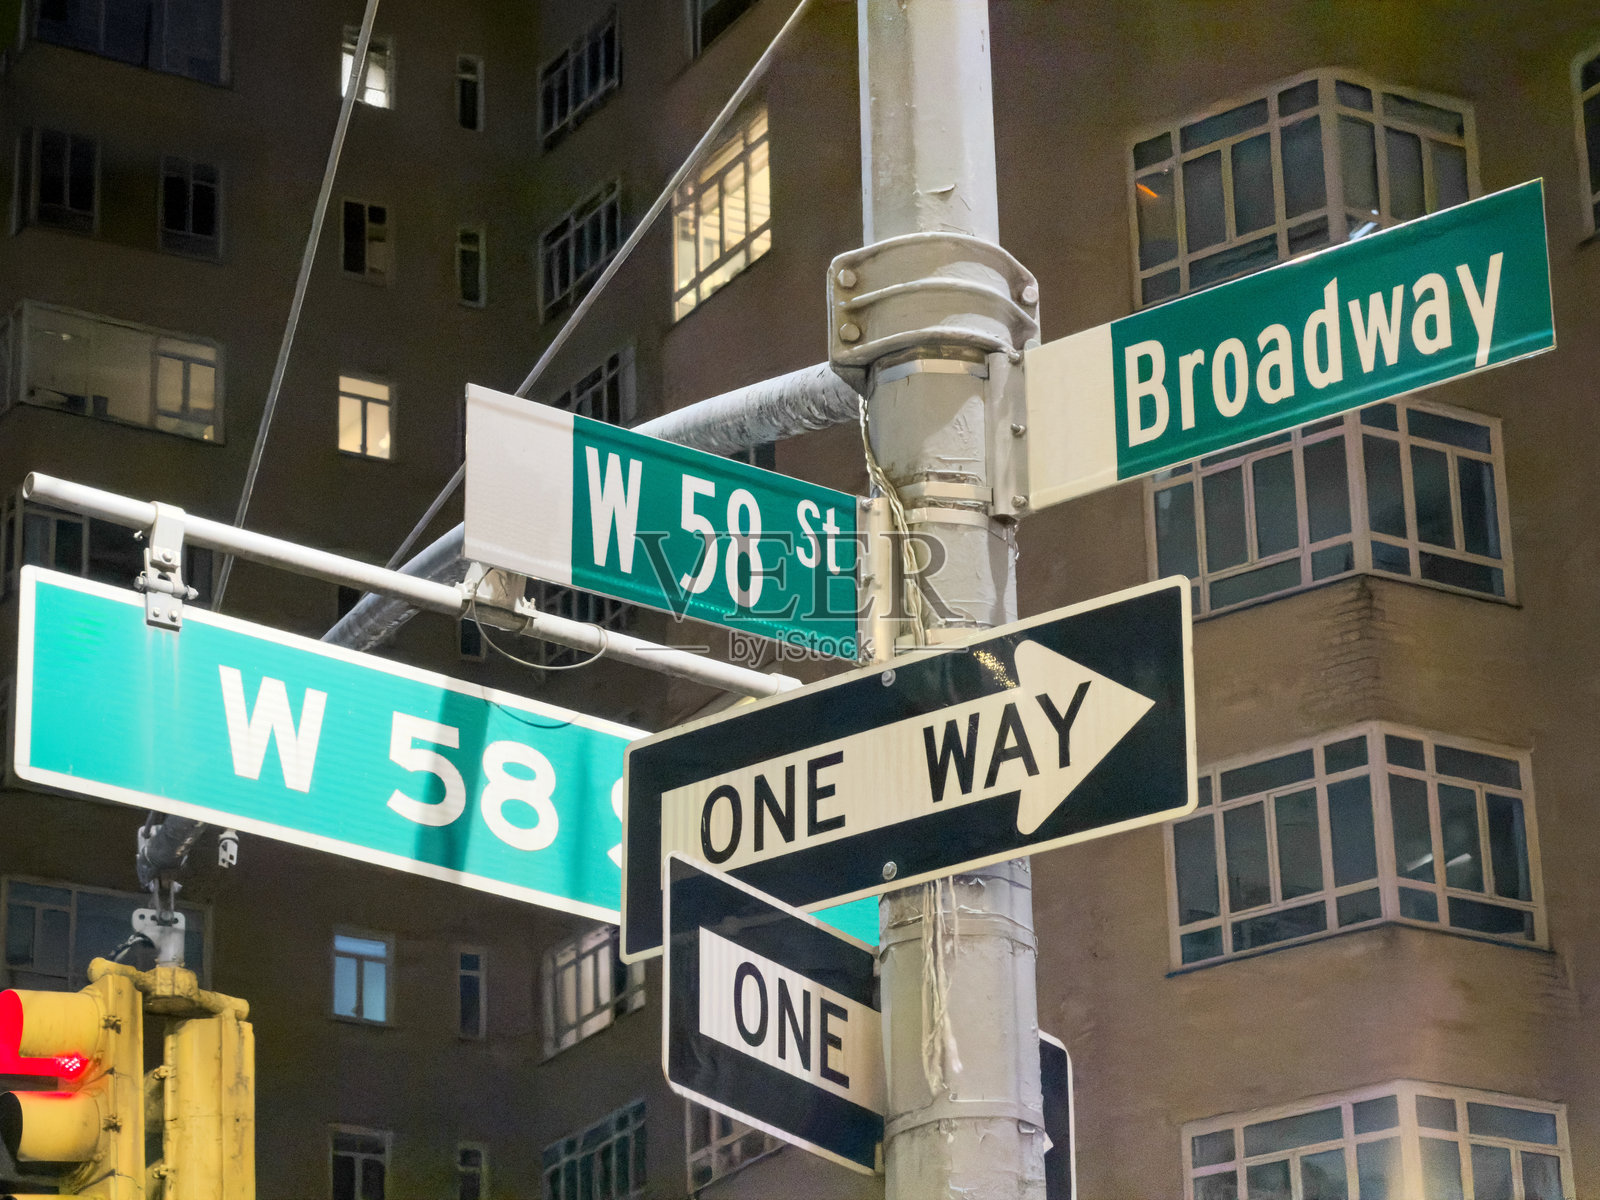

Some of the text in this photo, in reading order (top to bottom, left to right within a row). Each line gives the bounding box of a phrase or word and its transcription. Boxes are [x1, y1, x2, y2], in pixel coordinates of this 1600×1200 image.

[1125, 252, 1503, 447] Broadway
[585, 446, 841, 607] W 58 St
[219, 664, 328, 793] W
[387, 711, 559, 851] 58
[701, 751, 846, 864] ONE
[923, 681, 1092, 802] WAY
[734, 962, 850, 1089] ONE
